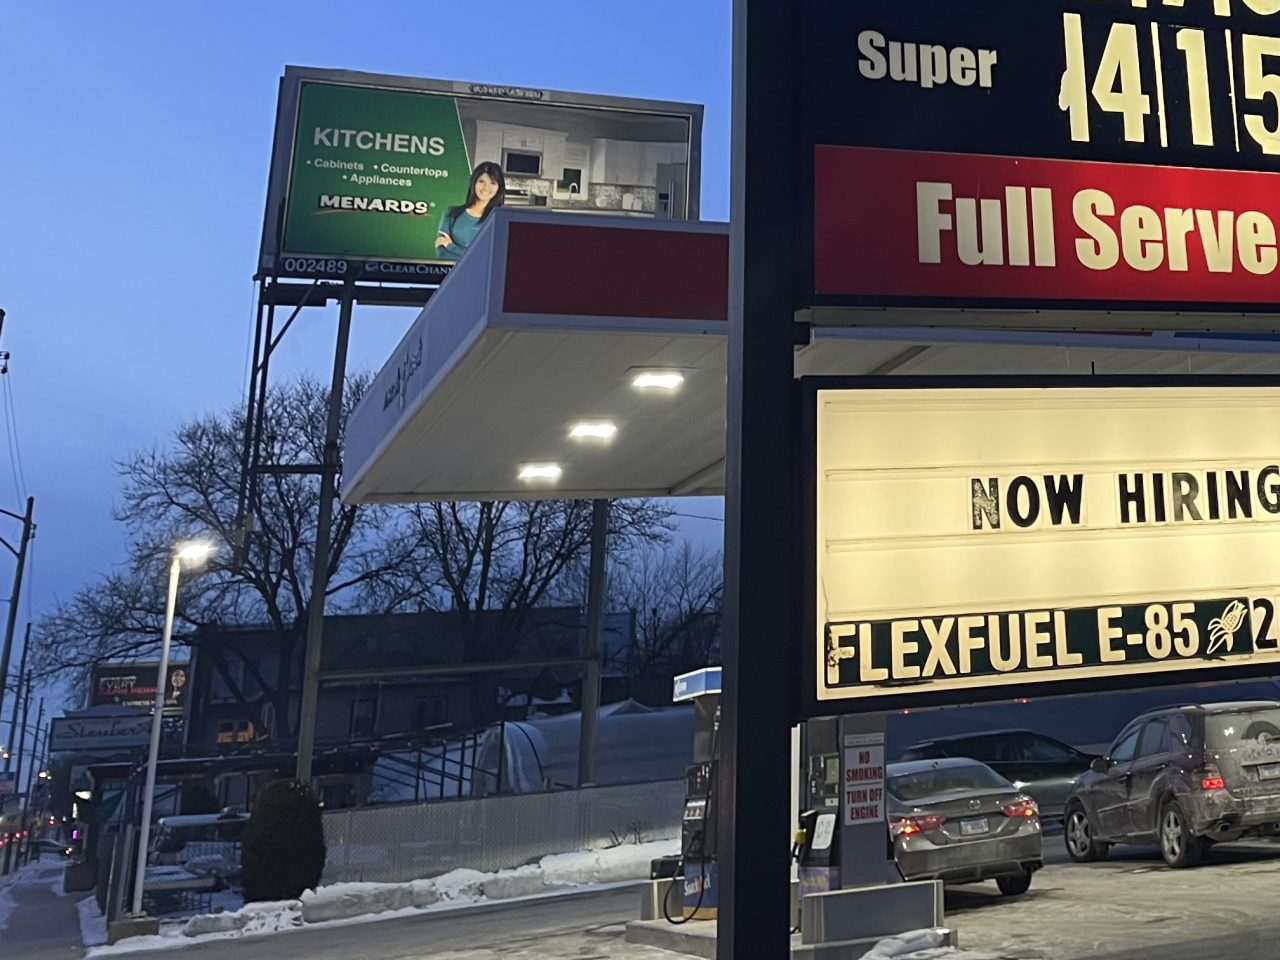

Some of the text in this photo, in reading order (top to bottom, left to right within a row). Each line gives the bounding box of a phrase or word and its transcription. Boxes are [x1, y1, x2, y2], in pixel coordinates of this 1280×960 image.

[857, 29, 998, 89] Super
[313, 127, 445, 156] KITCHENS
[314, 158, 449, 179] Cabinets Countertops
[350, 173, 412, 187] Appliances
[320, 194, 428, 214] MENARDS
[916, 181, 1278, 275] Full Serve
[284, 258, 347, 274] 002489
[970, 473, 1084, 531] NOW
[827, 610, 1083, 685] FLEXFUEL
[1097, 601, 1200, 663] E-85
[858, 751, 870, 765] NO
[846, 766, 883, 782] SMOKING
[846, 787, 882, 805] TURN OFF
[850, 804, 879, 820] ENGINE
